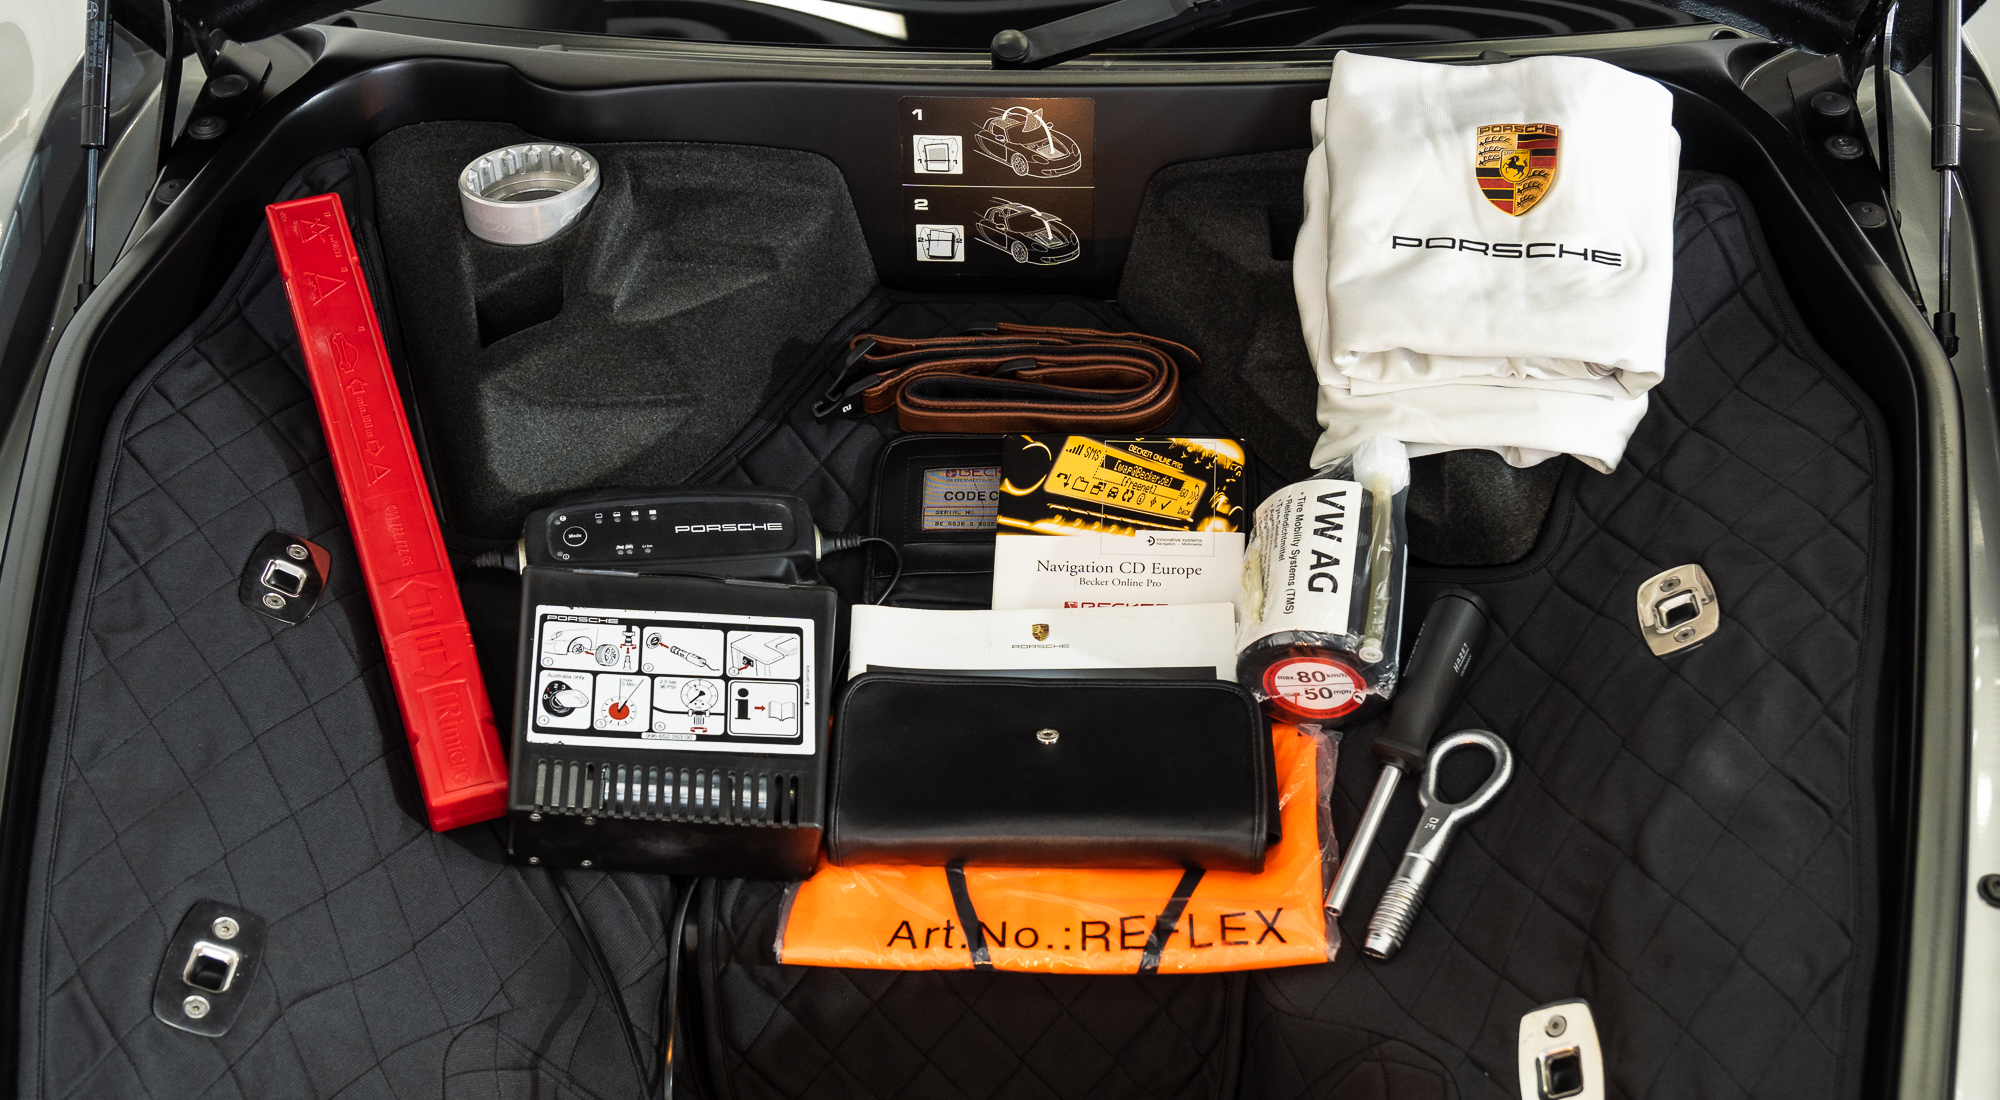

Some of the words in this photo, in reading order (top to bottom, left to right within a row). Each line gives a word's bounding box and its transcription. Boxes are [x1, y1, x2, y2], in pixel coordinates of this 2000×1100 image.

[911, 108, 923, 121] 1
[1479, 125, 1557, 135] PORSCHE
[913, 198, 929, 211] 2
[1392, 235, 1622, 267] PORSCHE
[1084, 446, 1102, 461] SMS
[1128, 444, 1153, 459] BECKER
[1152, 452, 1172, 466] ONLINE
[1171, 460, 1184, 470] PRO
[944, 491, 986, 501] CODE
[1295, 495, 1306, 513] Tire
[1177, 505, 1191, 516] back
[1313, 490, 1347, 543] VW
[675, 522, 783, 534] PORSCHE
[1278, 498, 1293, 562] Reifendichtmittel
[1294, 513, 1305, 549] Mobility
[1036, 559, 1113, 576] Navigation
[1119, 561, 1146, 574] CD
[1151, 562, 1203, 578] Europe
[1287, 549, 1300, 587] Systems
[1307, 549, 1341, 594] AG
[1079, 577, 1108, 586] Becker
[1112, 578, 1143, 587] Online
[1146, 579, 1162, 587] Pro
[1283, 588, 1296, 615] (TMS)
[547, 615, 619, 624] PORSCHE
[1453, 642, 1468, 673] HAZET
[1296, 671, 1326, 683] 80
[1304, 687, 1333, 700] 50
[1333, 688, 1352, 696] mph
